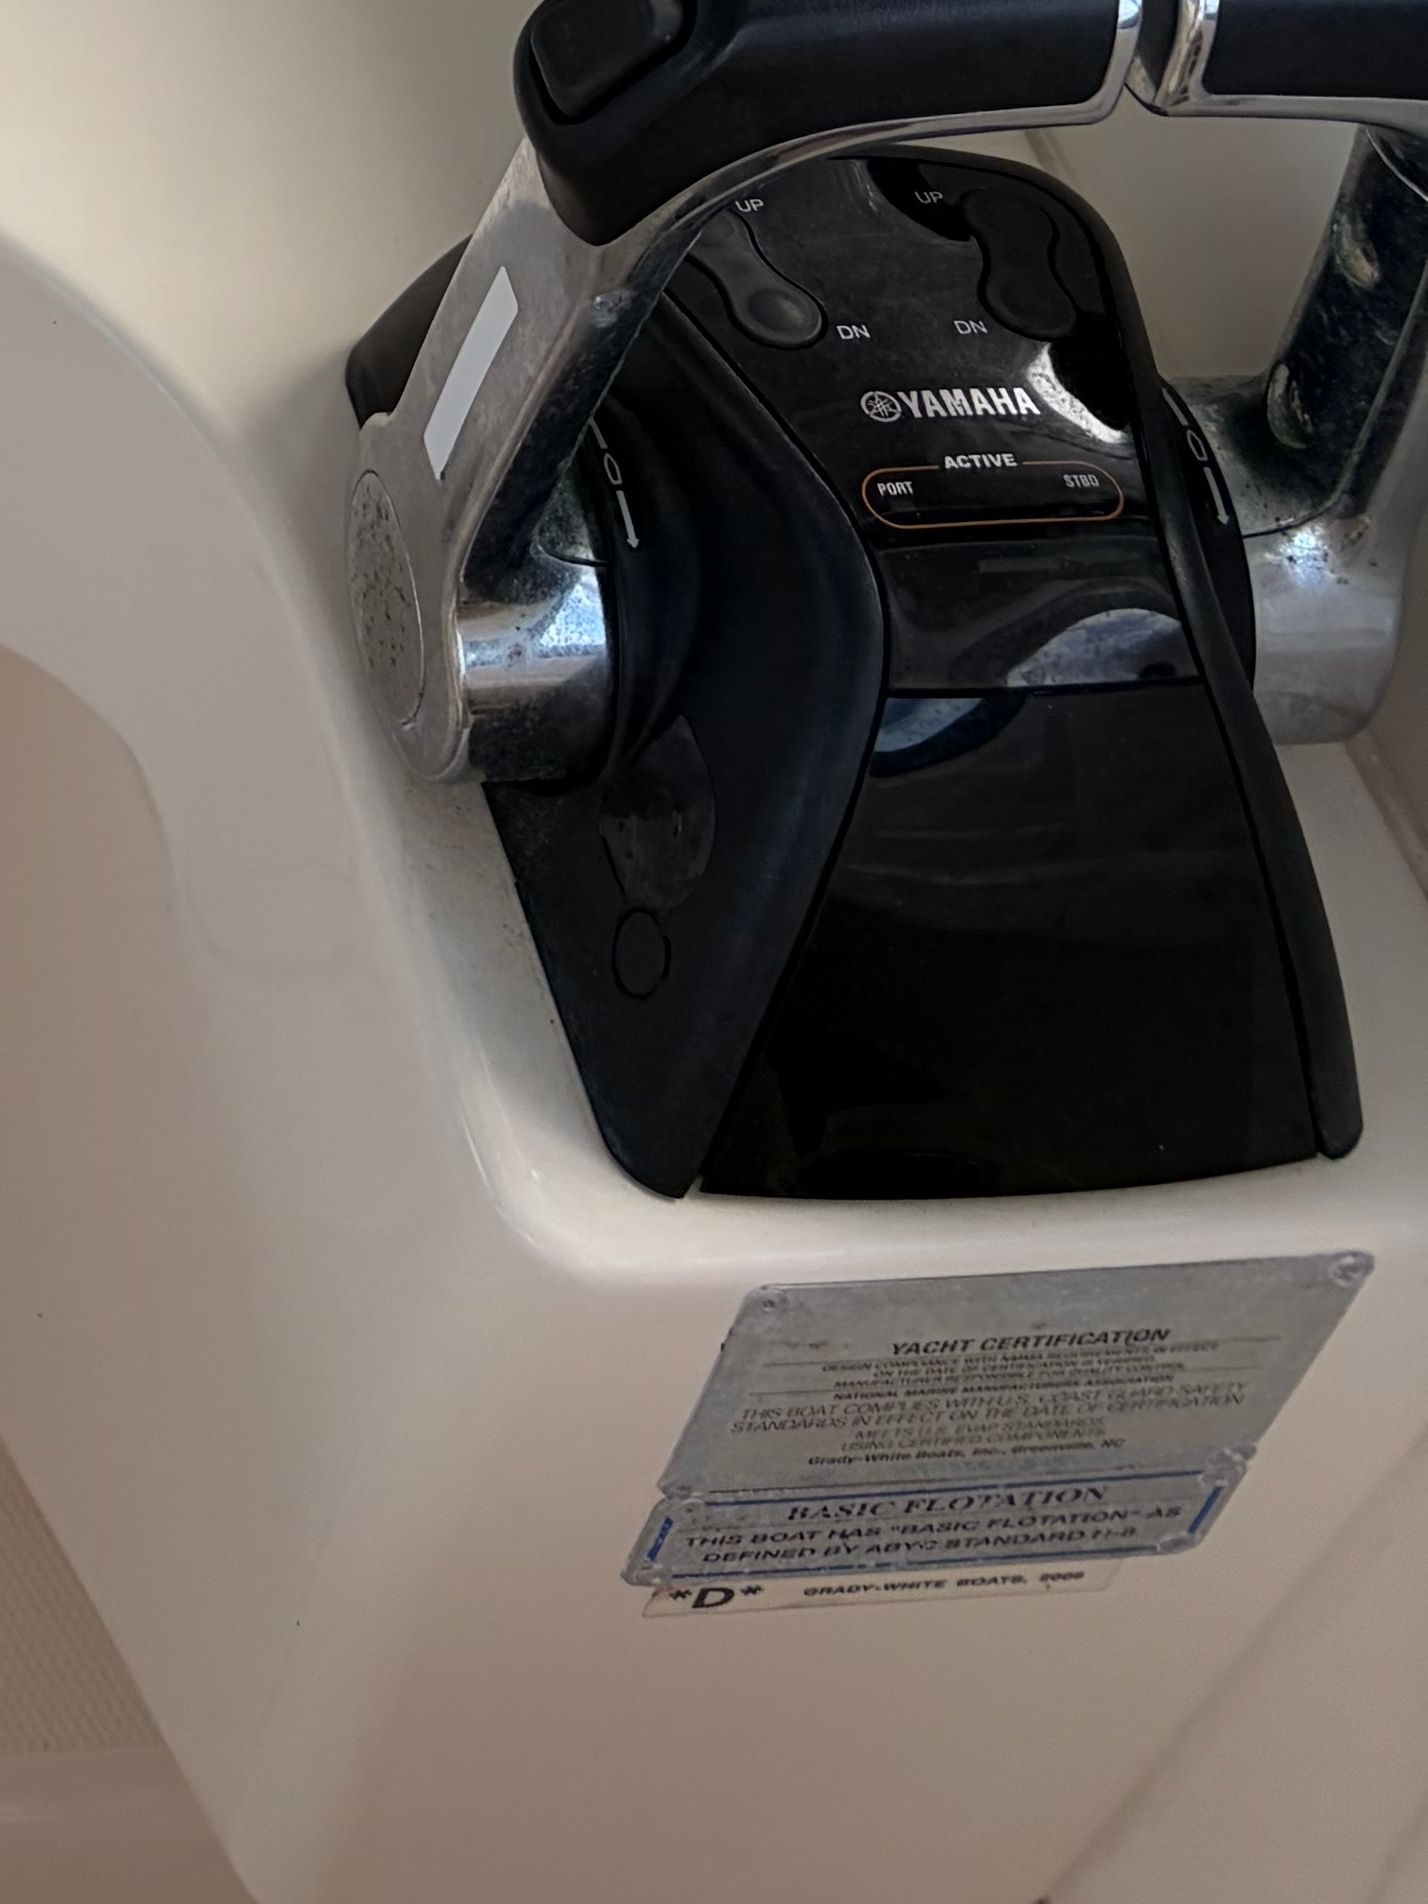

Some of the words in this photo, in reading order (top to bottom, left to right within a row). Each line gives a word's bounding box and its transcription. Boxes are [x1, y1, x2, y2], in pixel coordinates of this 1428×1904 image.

[735, 197, 765, 216] UP
[913, 189, 945, 206] UP
[836, 322, 872, 342] DN
[953, 318, 988, 336] DN
[899, 386, 1042, 421] YAMAHA
[943, 450, 1018, 471] ACTIVE
[876, 479, 916, 498] PORT
[1062, 472, 1101, 490] STBD
[892, 1337, 975, 1356] YACHT
[980, 1328, 1171, 1352] CERTIFICATION
[742, 1407, 783, 1419] THIS
[785, 1403, 839, 1418] BOAT
[843, 1399, 940, 1415] COMPLIES
[730, 1417, 846, 1433] STANDARDS
[808, 1450, 913, 1466] Grady-White
[787, 1498, 897, 1521] BASIC
[902, 1485, 1109, 1514] FLOTATION
[686, 1534, 742, 1548] THIS
[750, 1529, 821, 1543] BOAT
[828, 1527, 881, 1540] HAS
[891, 1520, 980, 1535] "BASIC
[1146, 1506, 1183, 1519] AS
[702, 1547, 817, 1562] DEFINED
[824, 1543, 860, 1556] BY
[944, 1529, 1087, 1550] STANDARD
[803, 1577, 948, 1597] GRADY-WHITE
